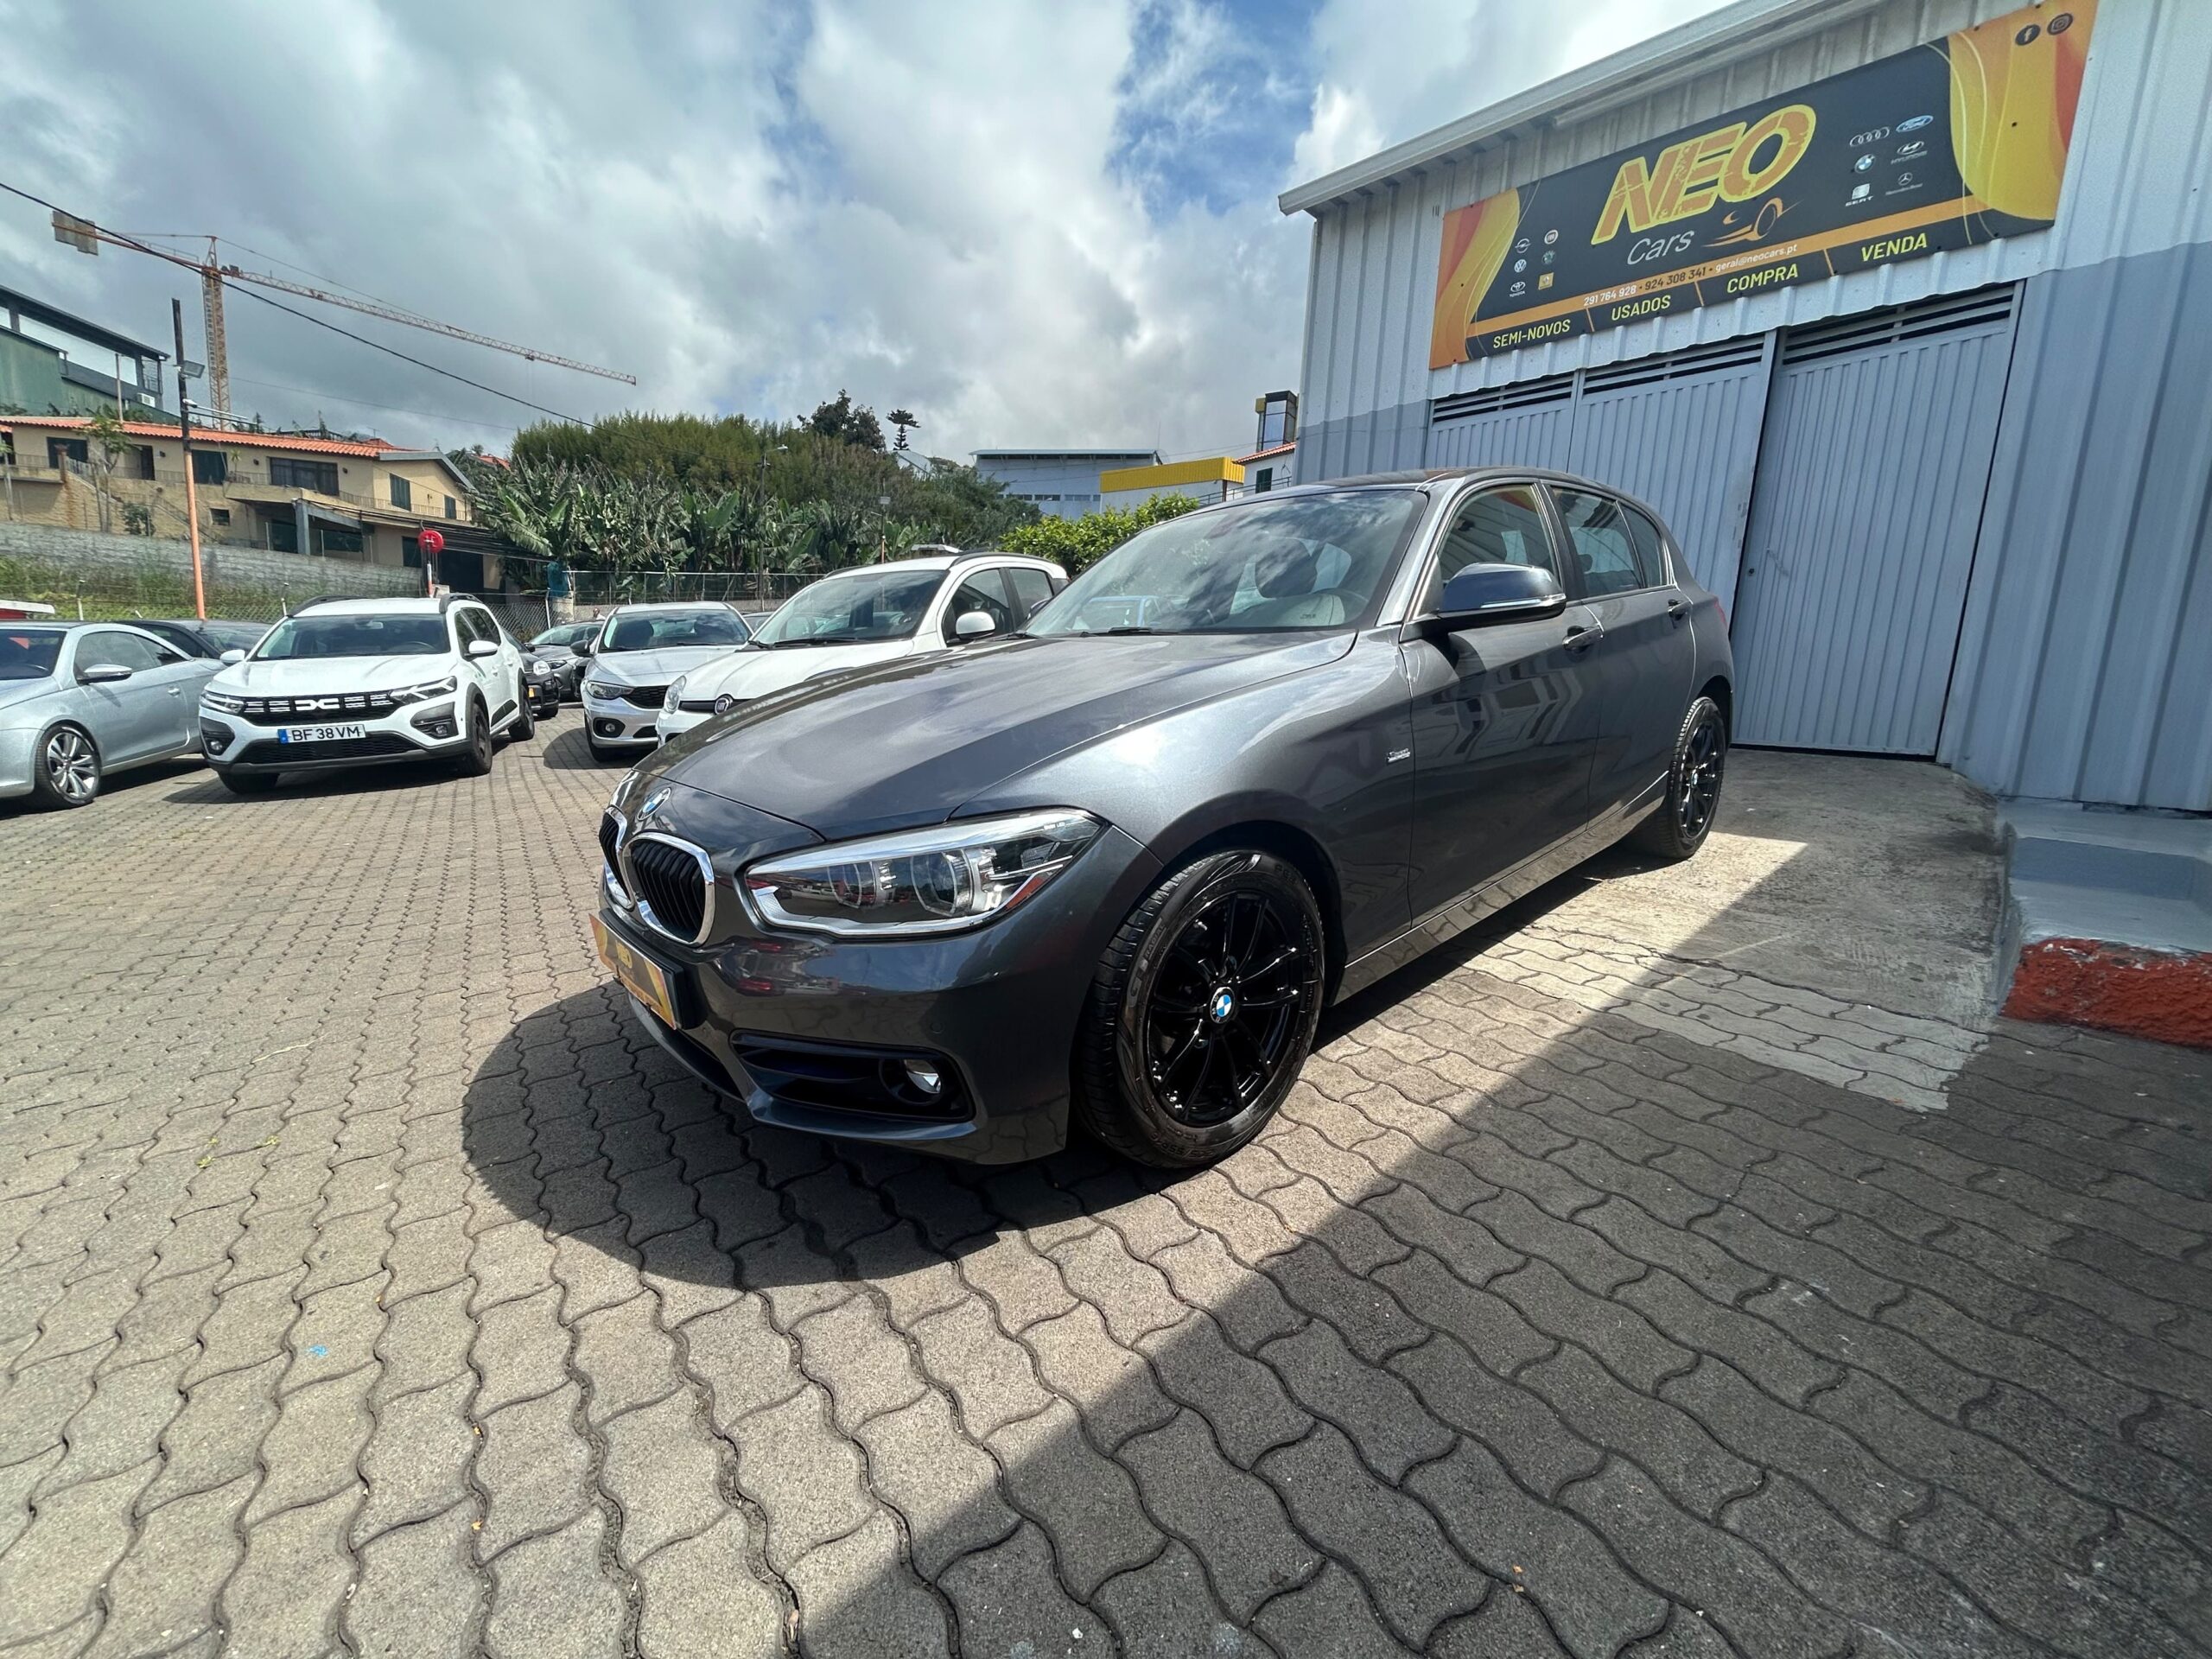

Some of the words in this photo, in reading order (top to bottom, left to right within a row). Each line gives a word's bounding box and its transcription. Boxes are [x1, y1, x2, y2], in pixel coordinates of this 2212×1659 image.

[1591, 104, 1816, 245] NEO
[1583, 295, 1599, 307] 291
[1600, 290, 1617, 301] 764
[1618, 285, 1637, 297] 928
[1645, 279, 1664, 290] 924
[1667, 272, 1686, 285] 308
[1688, 267, 1707, 280] 341
[1715, 244, 1797, 273] geral@neocars.pt
[1627, 230, 1695, 265] Cars
[1493, 319, 1571, 349] SEMI-NOVOS
[1611, 295, 1671, 321] USADOS
[1726, 263, 1799, 294] COMPRA
[1861, 232, 1928, 262] VENDA
[291, 729, 313, 741] BF
[315, 728, 334, 740] 38
[335, 726, 360, 738] VM
